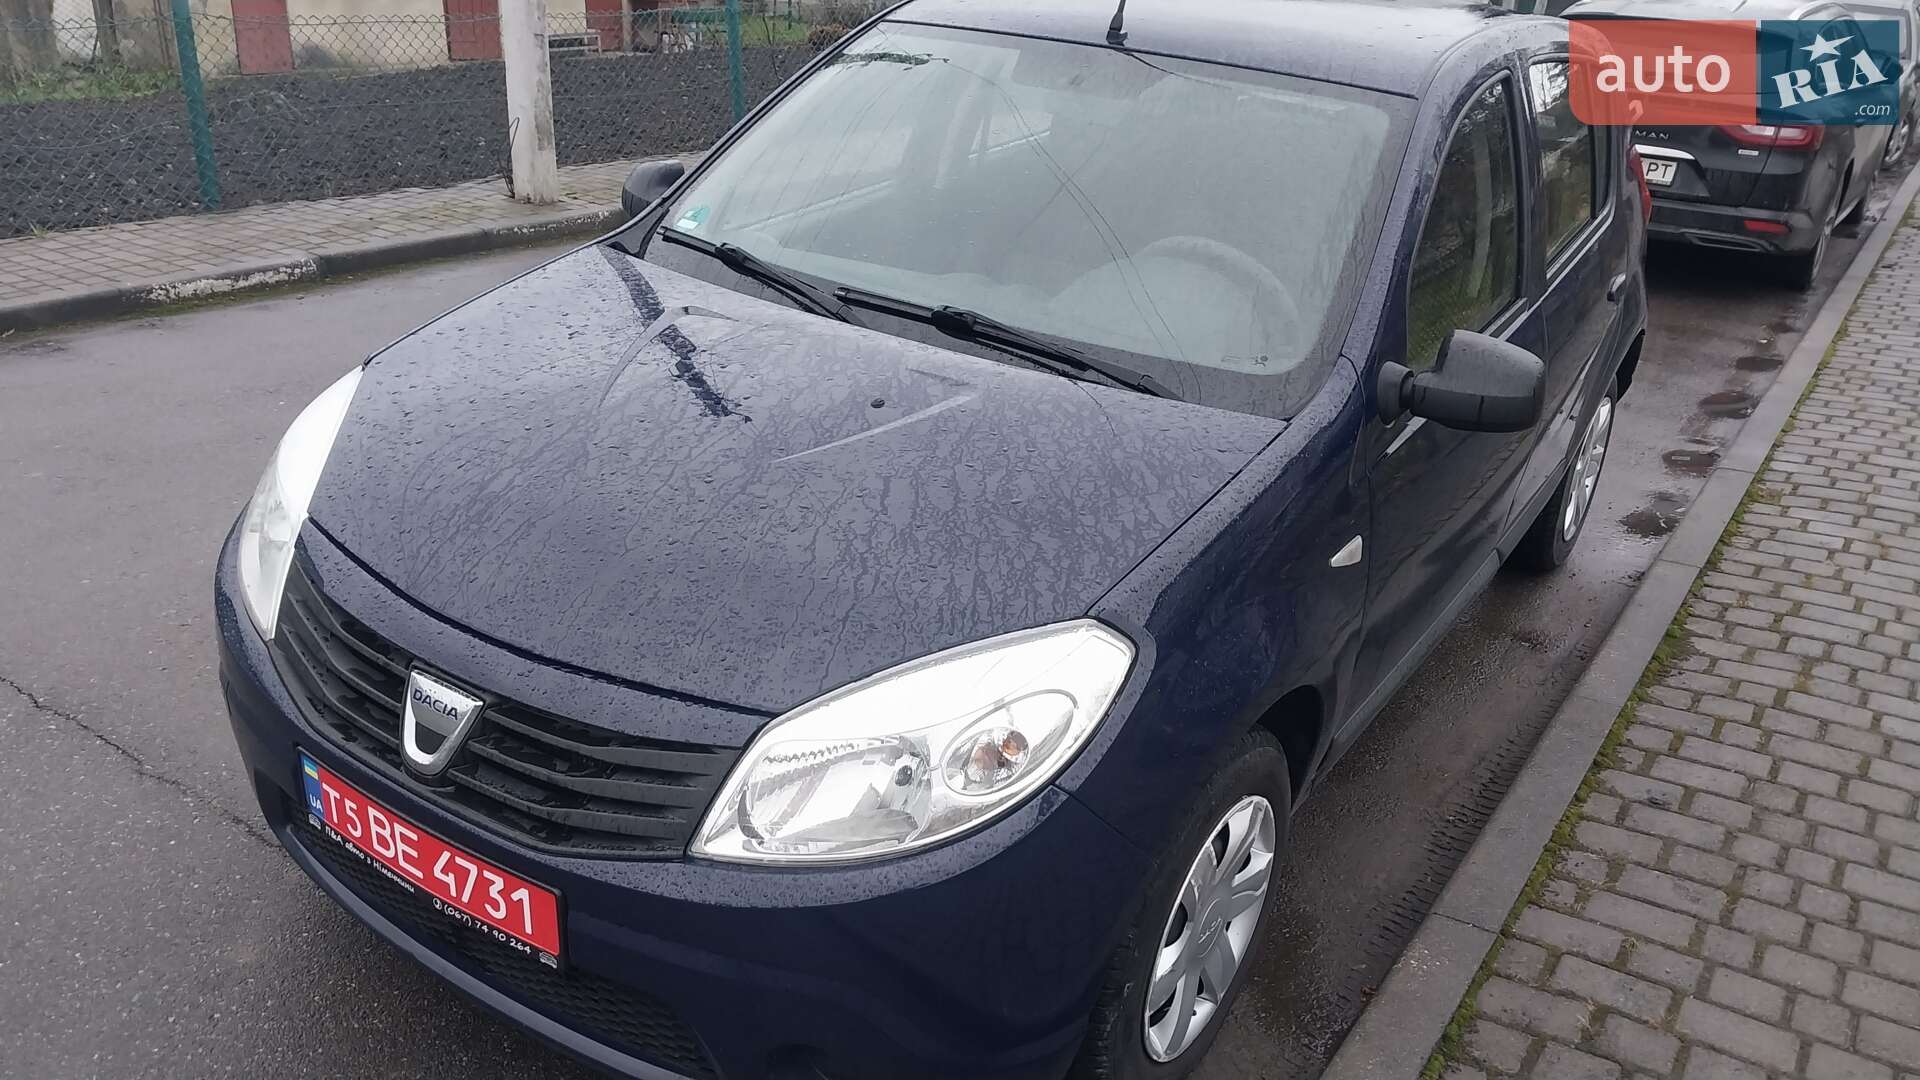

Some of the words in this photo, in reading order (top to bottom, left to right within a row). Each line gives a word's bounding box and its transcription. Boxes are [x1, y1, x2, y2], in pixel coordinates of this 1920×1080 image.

[412, 687, 459, 721] DACIA
[309, 794, 324, 813] UA
[432, 850, 533, 936] 4731
[444, 903, 472, 927] (067)
[475, 920, 489, 934] 74
[492, 929, 507, 942] 90
[510, 938, 532, 955] 264
